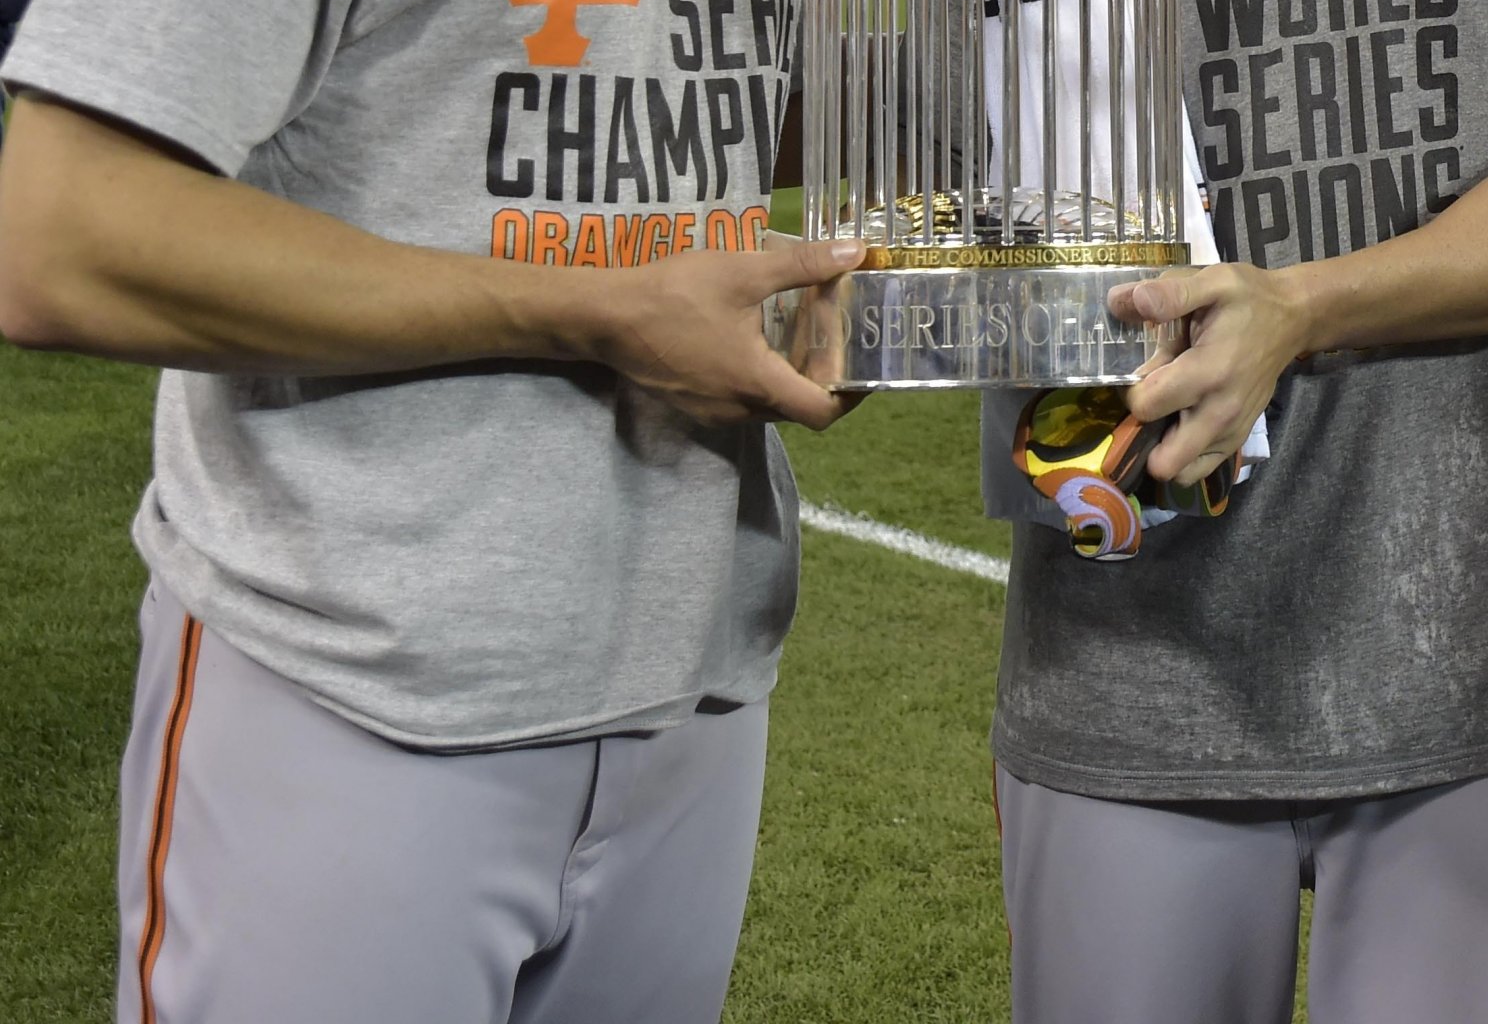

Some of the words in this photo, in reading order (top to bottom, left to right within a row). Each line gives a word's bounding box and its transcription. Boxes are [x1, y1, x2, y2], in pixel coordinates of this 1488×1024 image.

[1199, 24, 1459, 182] SERIES
[491, 207, 695, 269] ORANGE
[902, 251, 940, 266] THE
[947, 249, 1094, 265] COMMISSIONER
[1098, 248, 1117, 262] OF
[861, 303, 1009, 349] SERIES
